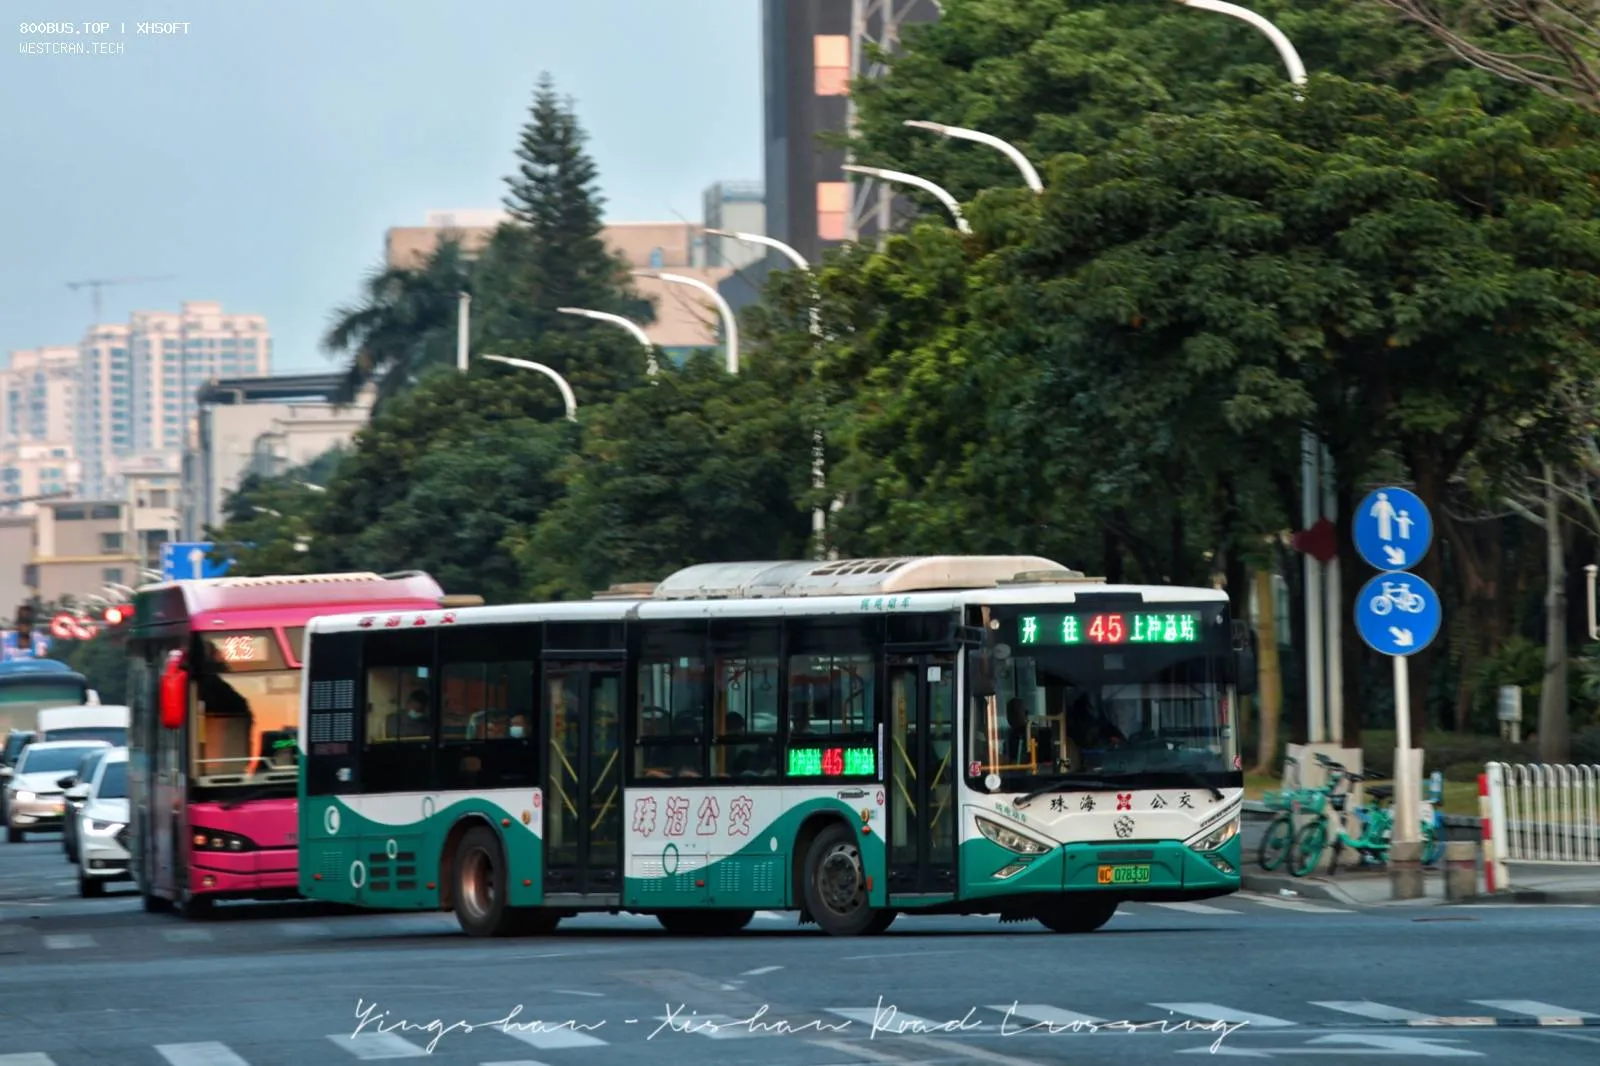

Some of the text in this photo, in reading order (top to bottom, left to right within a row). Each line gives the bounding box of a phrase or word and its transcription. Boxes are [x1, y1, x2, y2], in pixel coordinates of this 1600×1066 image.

[1089, 614, 1122, 642] 45
[822, 748, 843, 775] 45
[632, 795, 753, 837] 珠海公交
